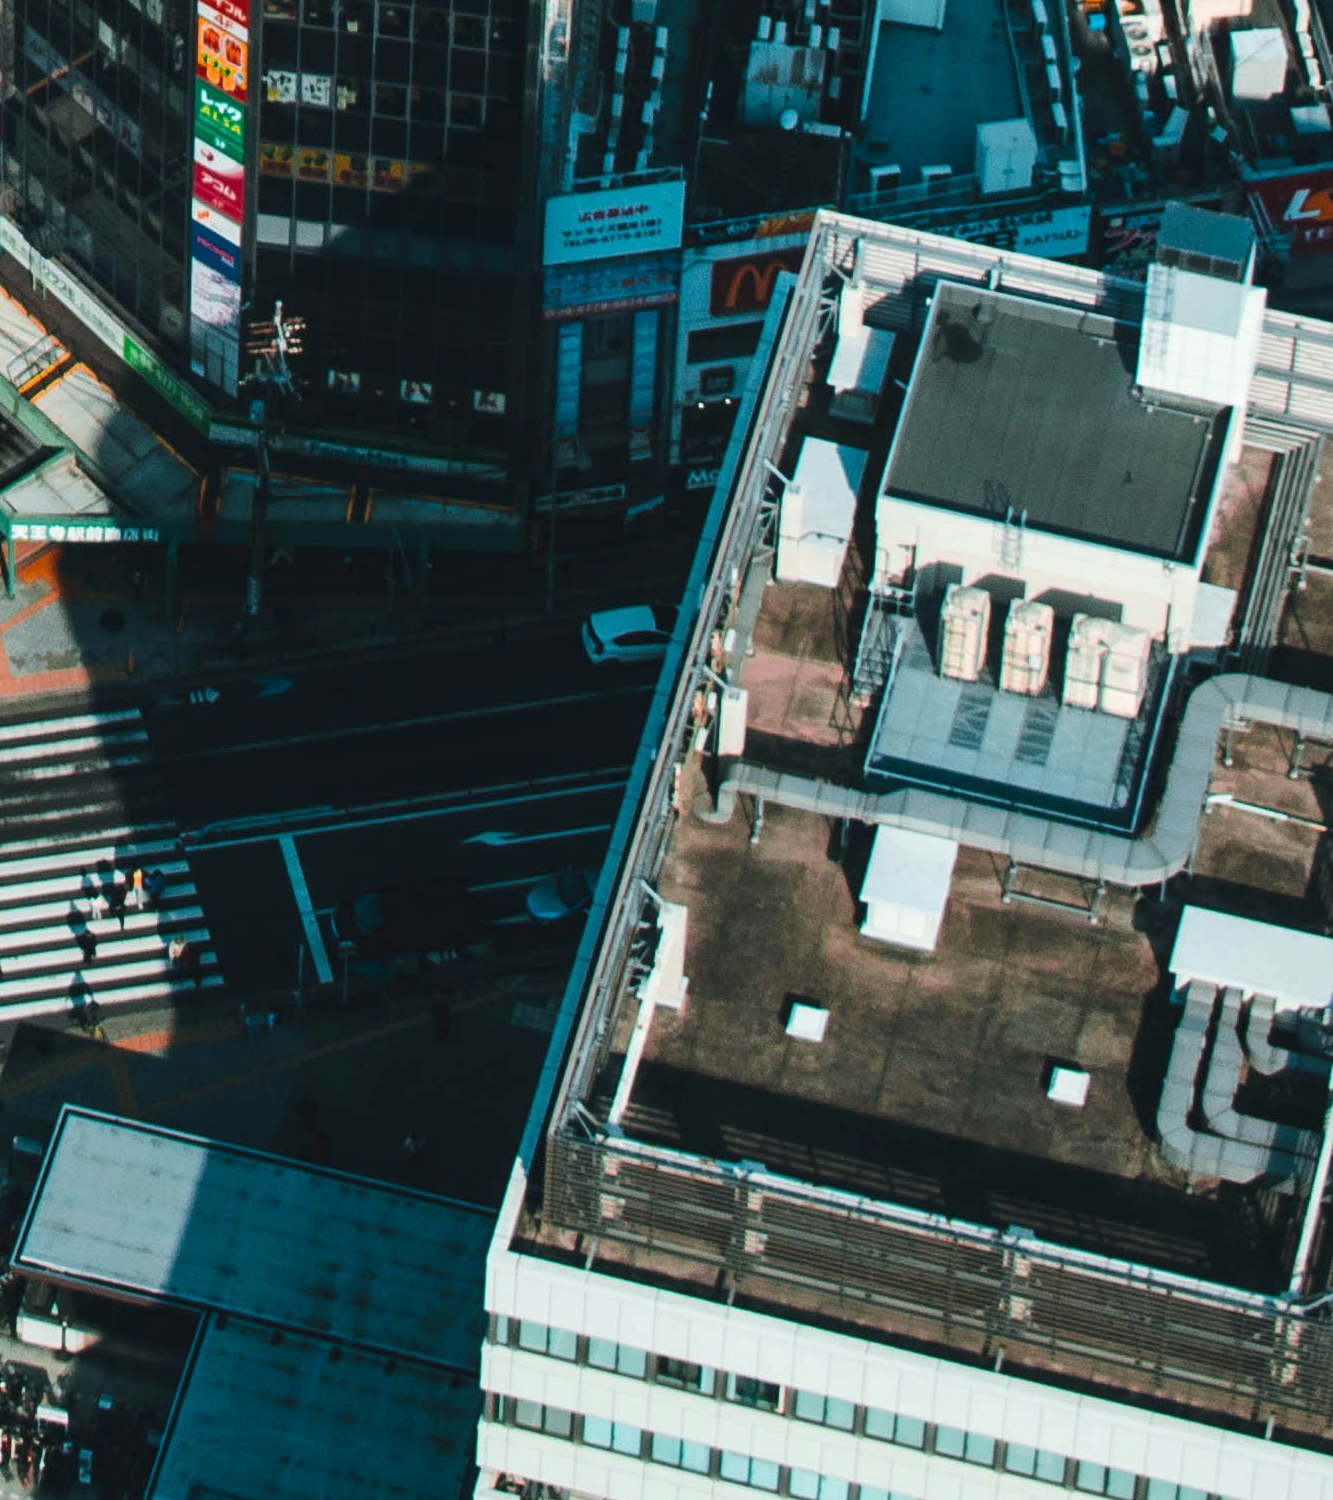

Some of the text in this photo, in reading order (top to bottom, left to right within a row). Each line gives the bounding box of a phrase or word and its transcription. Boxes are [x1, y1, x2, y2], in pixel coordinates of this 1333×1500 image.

[201, 88, 242, 122] レイク
[201, 170, 237, 201] アコム
